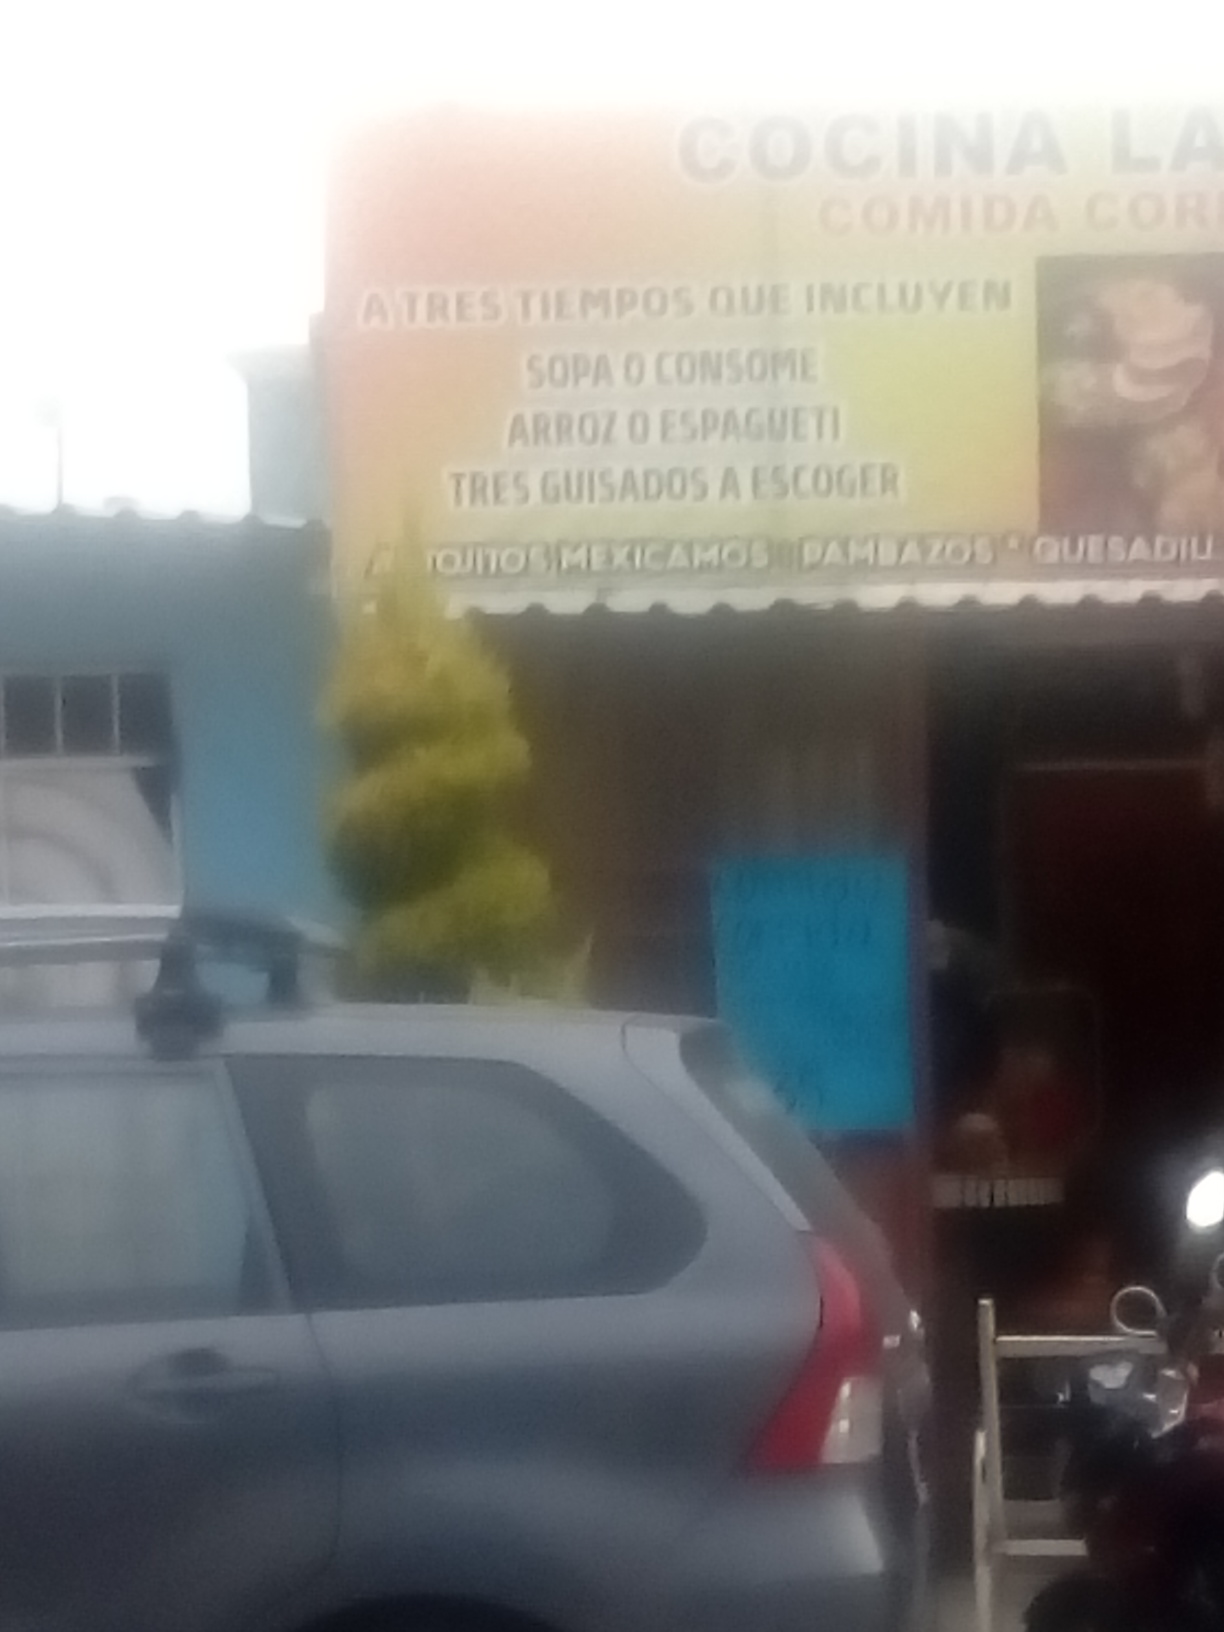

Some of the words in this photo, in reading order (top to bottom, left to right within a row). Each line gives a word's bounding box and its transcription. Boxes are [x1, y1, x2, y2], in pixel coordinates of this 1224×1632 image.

[678, 111, 1068, 182] COCINA
[819, 194, 1058, 238] COMIDA
[362, 291, 394, 324] A
[405, 288, 502, 323] TRES
[517, 283, 694, 321] TIEMPOS
[708, 281, 791, 318] QUE
[806, 278, 1011, 315] INCLUYEN
[527, 352, 611, 388] SOPA
[625, 352, 645, 387] O
[655, 347, 818, 386] CONSOME
[508, 411, 618, 447] ARROZ
[629, 410, 649, 445] O
[660, 406, 840, 443] ESPAGUETI
[450, 471, 530, 507] TRES
[540, 467, 707, 505] GUISADOS
[719, 466, 741, 501] A
[751, 462, 900, 500] ESCOGER
[366, 545, 547, 577] ATOJITOS
[803, 538, 993, 567] PAMBAZOS
